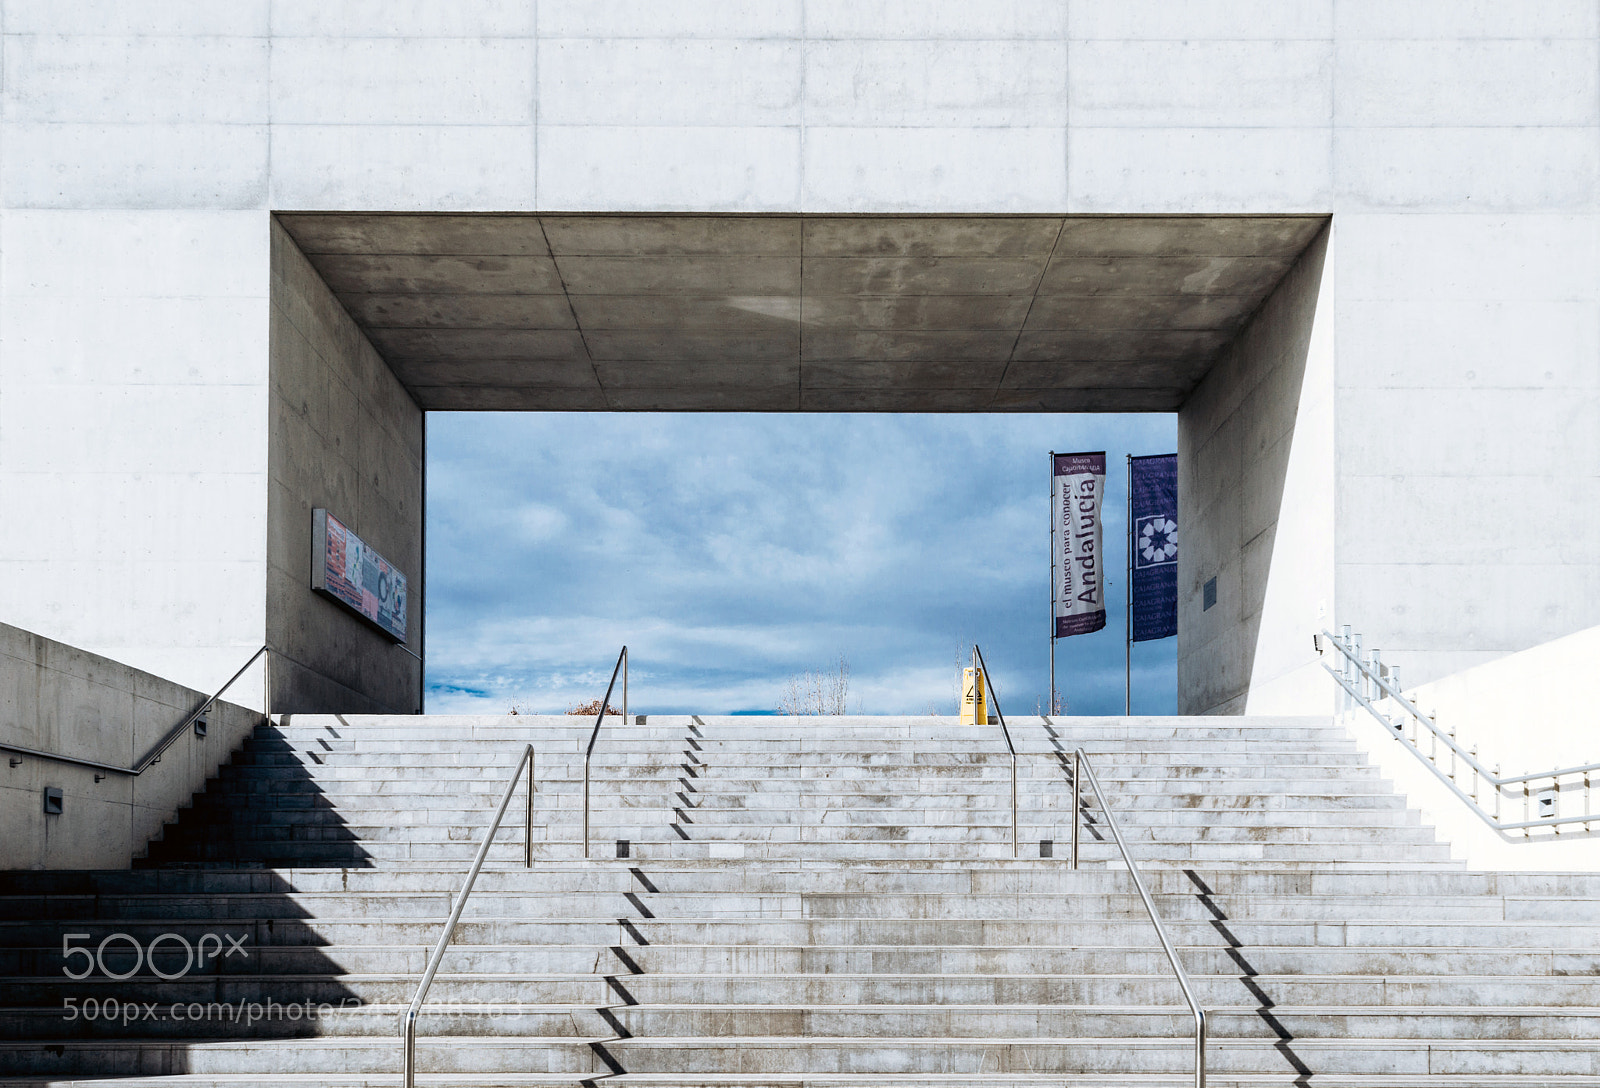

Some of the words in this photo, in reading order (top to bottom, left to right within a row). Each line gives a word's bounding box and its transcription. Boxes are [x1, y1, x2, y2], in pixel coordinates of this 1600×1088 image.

[1063, 483, 1071, 526] conocer
[1063, 529, 1073, 554] para
[1075, 479, 1096, 604] Andalucía
[1063, 558, 1072, 595] museo
[1062, 598, 1073, 609] el
